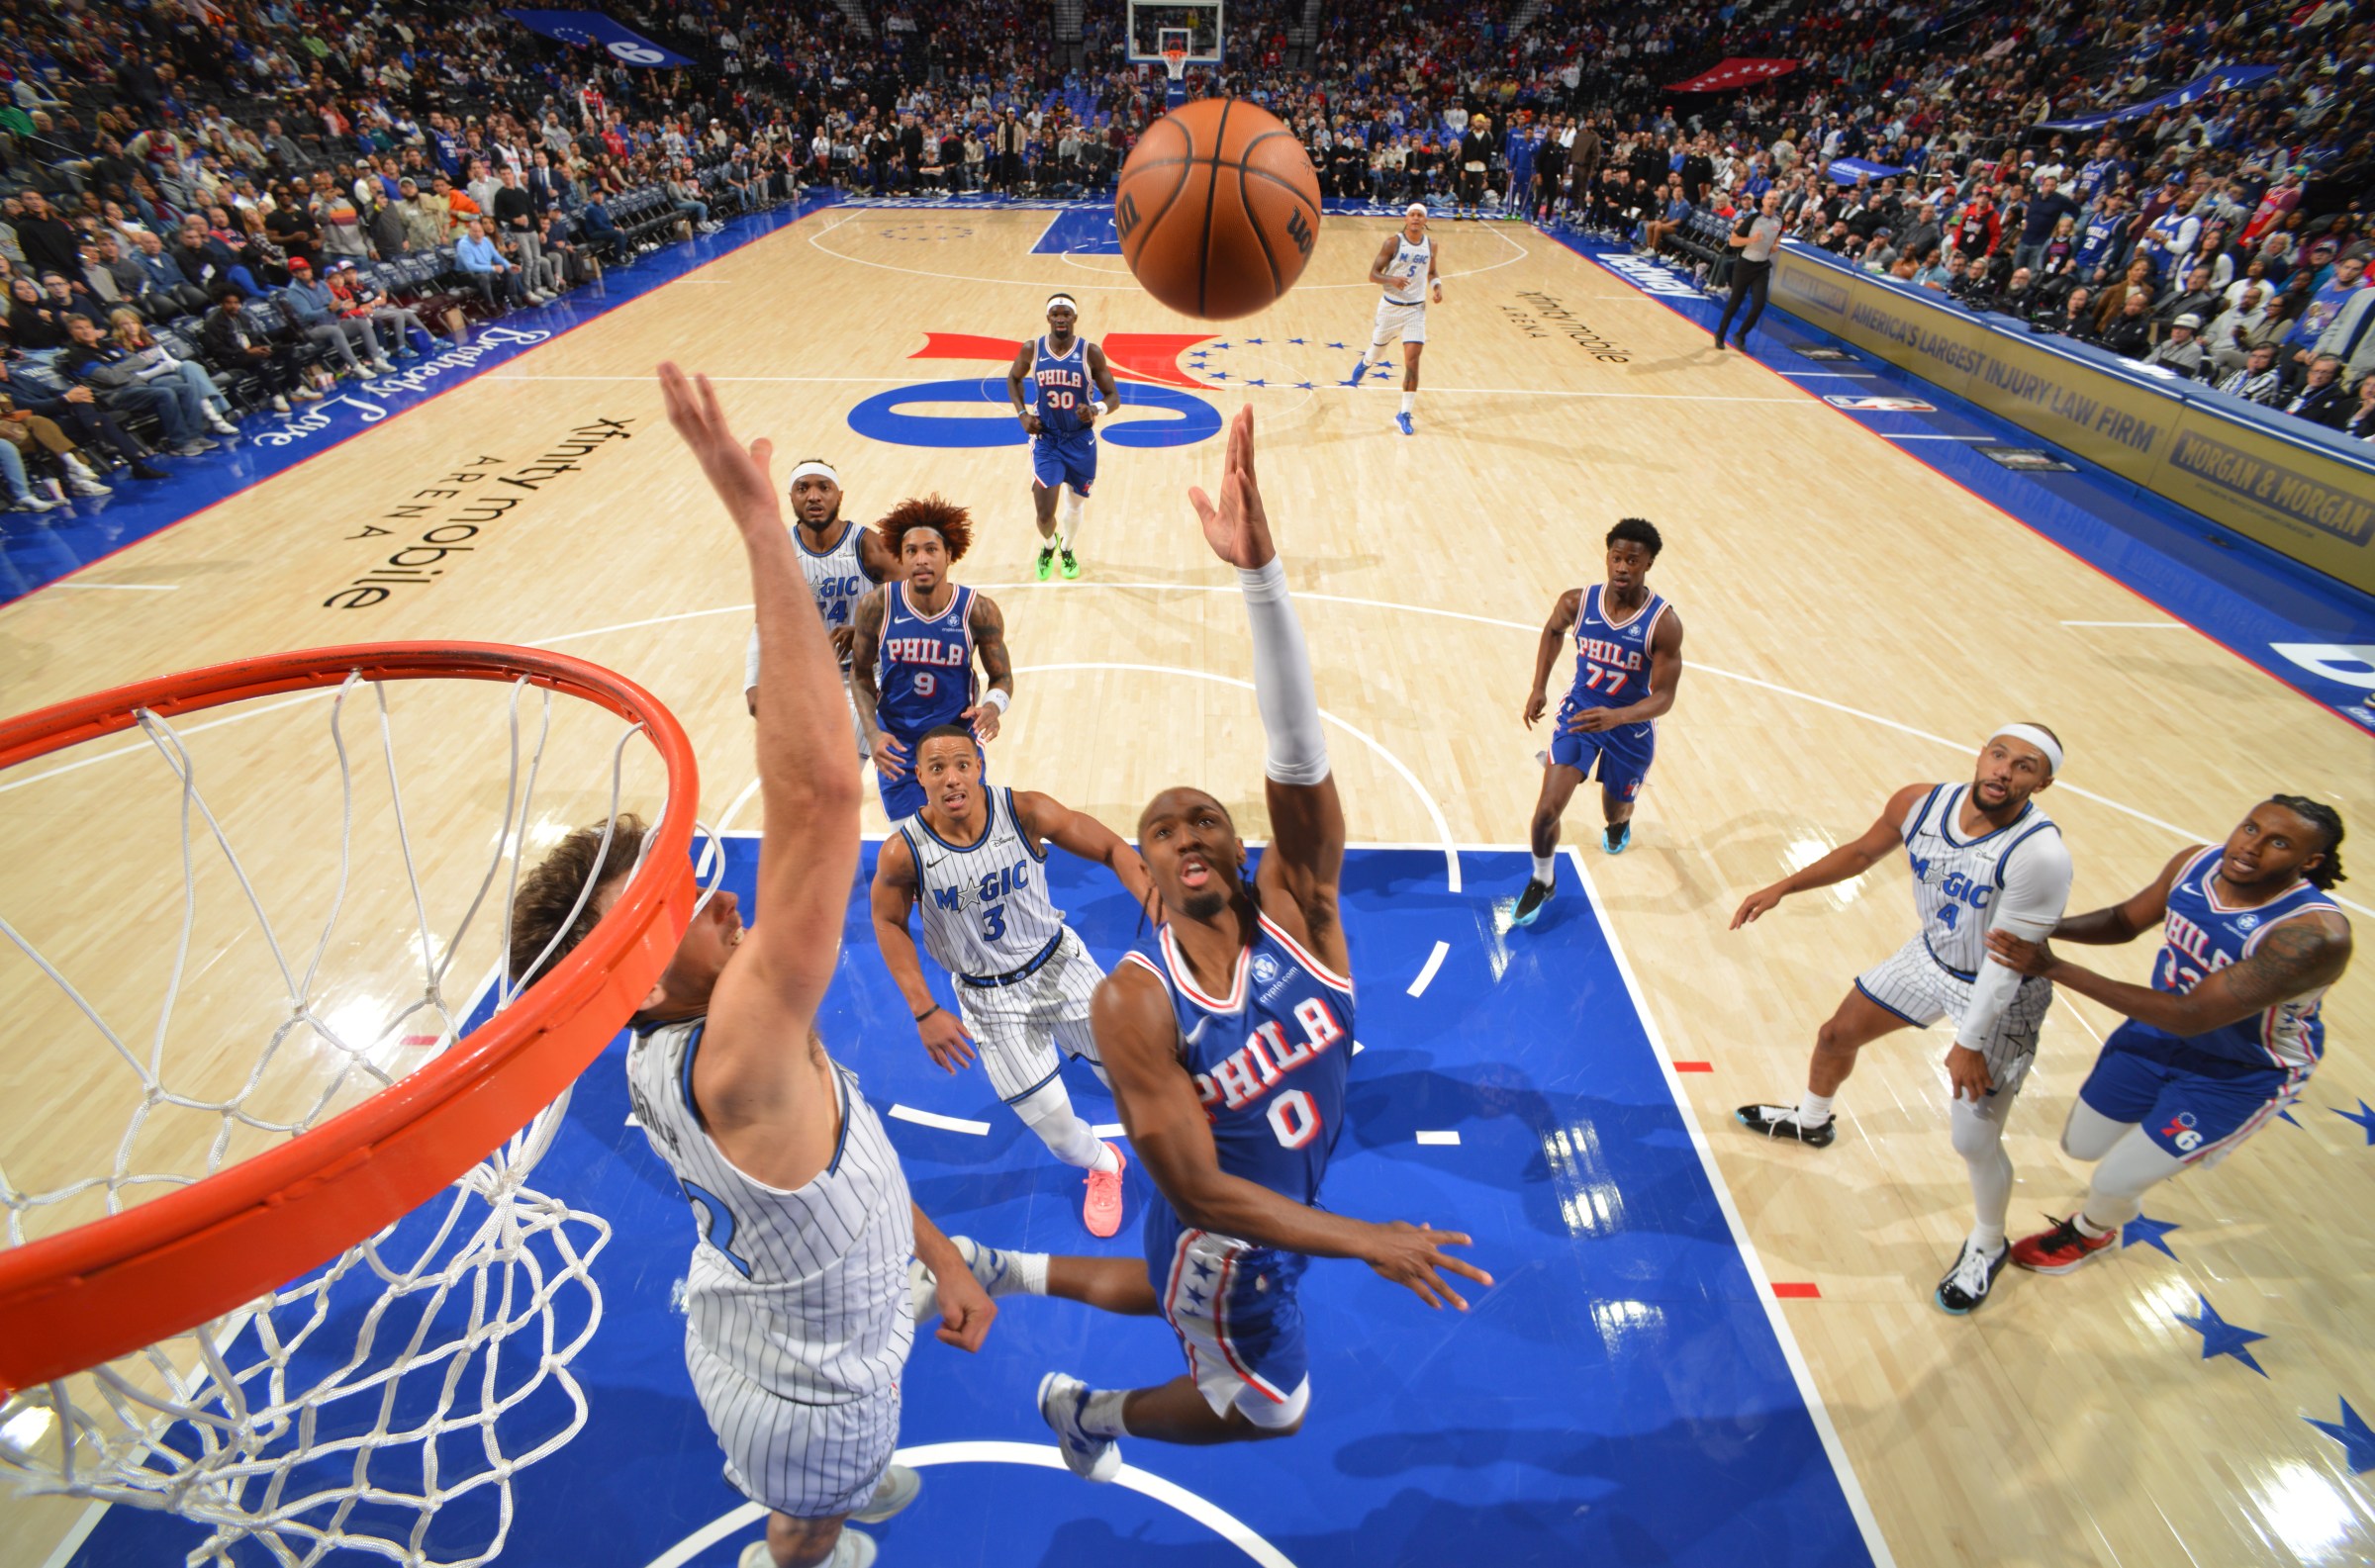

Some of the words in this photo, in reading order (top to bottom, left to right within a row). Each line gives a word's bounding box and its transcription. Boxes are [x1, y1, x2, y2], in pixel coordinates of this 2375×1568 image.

[1406, 265, 1417, 277] 5
[1595, 252, 1711, 300] betway
[1496, 305, 1551, 338] ARENA
[1515, 291, 1578, 323] xfinity
[1556, 323, 1633, 364] mobile
[360, 325, 551, 398] Brotherly
[1036, 369, 1083, 388] PHILA
[1850, 301, 1919, 348] AMERICA'S
[1919, 323, 1986, 377] LARGEST
[1985, 356, 2051, 412] INJURY
[2048, 385, 2102, 426] LAW
[1046, 390, 1076, 410] 30
[253, 393, 388, 447] Love
[498, 417, 636, 490] xfinity
[343, 455, 507, 540] ARENA
[2178, 436, 2259, 491] MORGAN
[2254, 469, 2276, 498] &
[2273, 476, 2372, 536] MORGAN
[323, 498, 523, 609] mobile
[886, 637, 965, 667] PHILA
[1576, 635, 1644, 671] PHILA
[913, 672, 937, 697] 9
[1585, 662, 1629, 696] 77
[992, 835, 1015, 848] Disney
[983, 903, 1006, 942] 3
[1937, 903, 1960, 931] 4
[1259, 966, 1300, 1004] crypto.com
[1266, 1088, 1322, 1150] 0
[2160, 1115, 2204, 1152] 76
